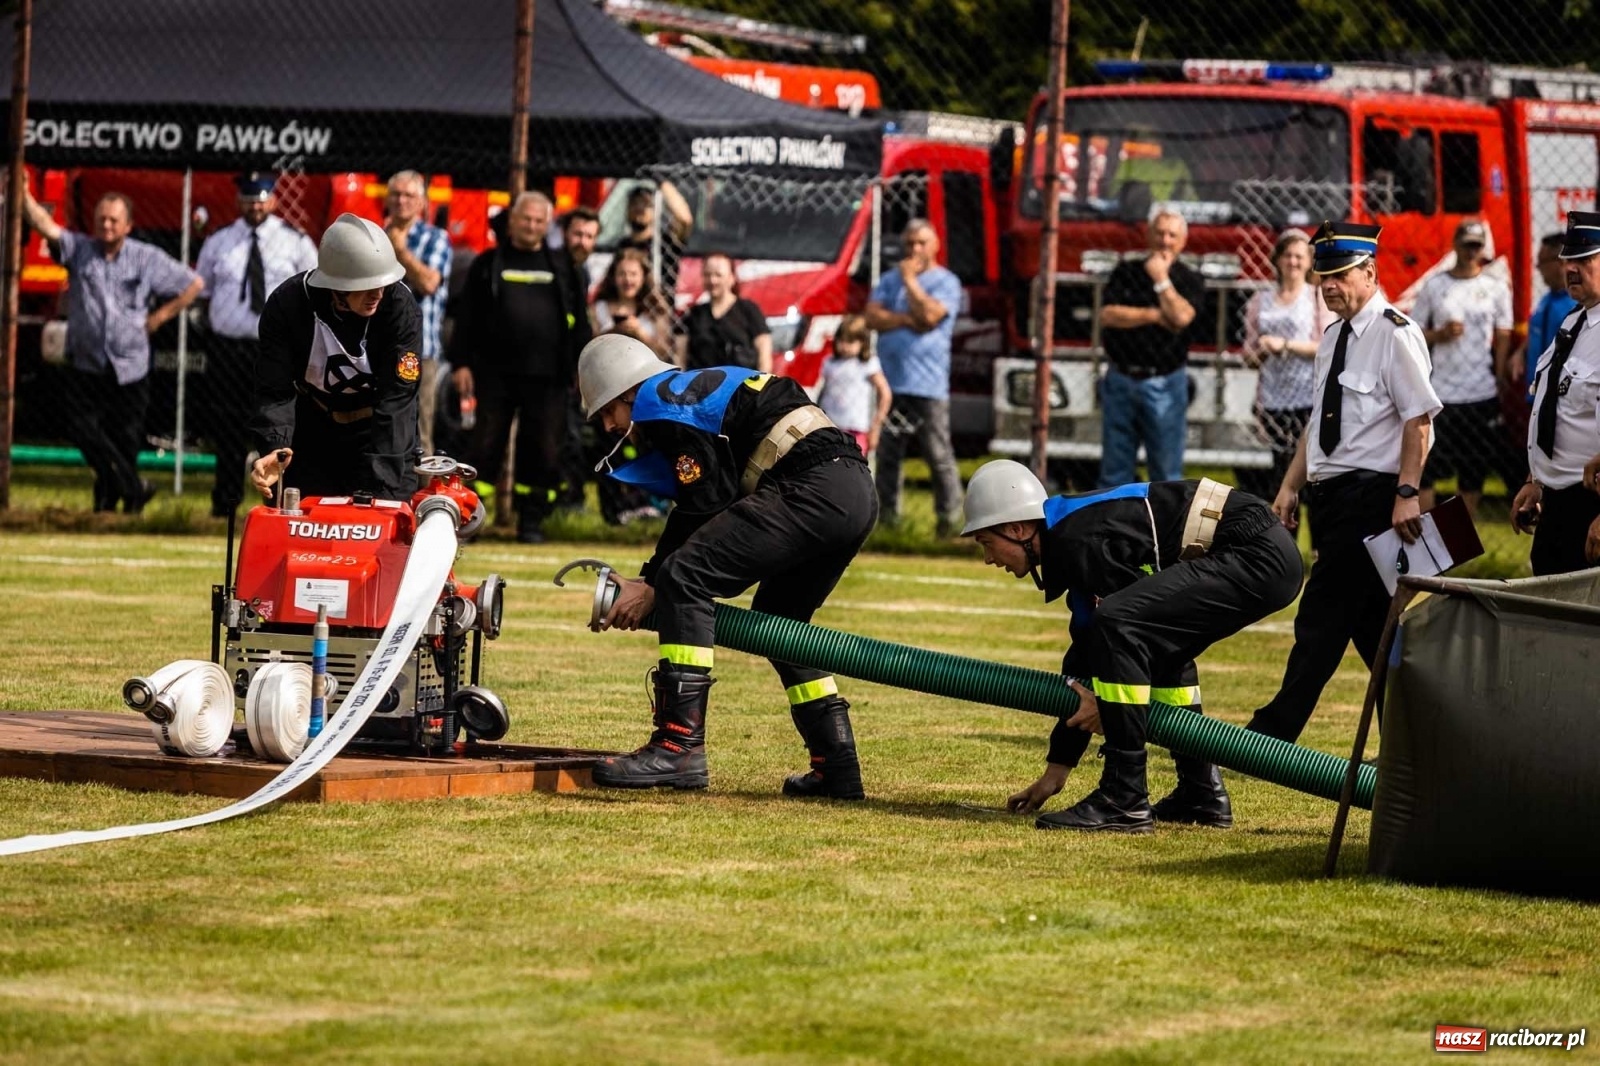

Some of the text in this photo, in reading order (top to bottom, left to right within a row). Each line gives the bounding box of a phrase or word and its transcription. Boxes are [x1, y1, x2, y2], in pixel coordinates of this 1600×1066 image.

[23, 119, 332, 155] SOŁECTWO PAWŁÓW
[288, 520, 383, 541] TOHATSU
